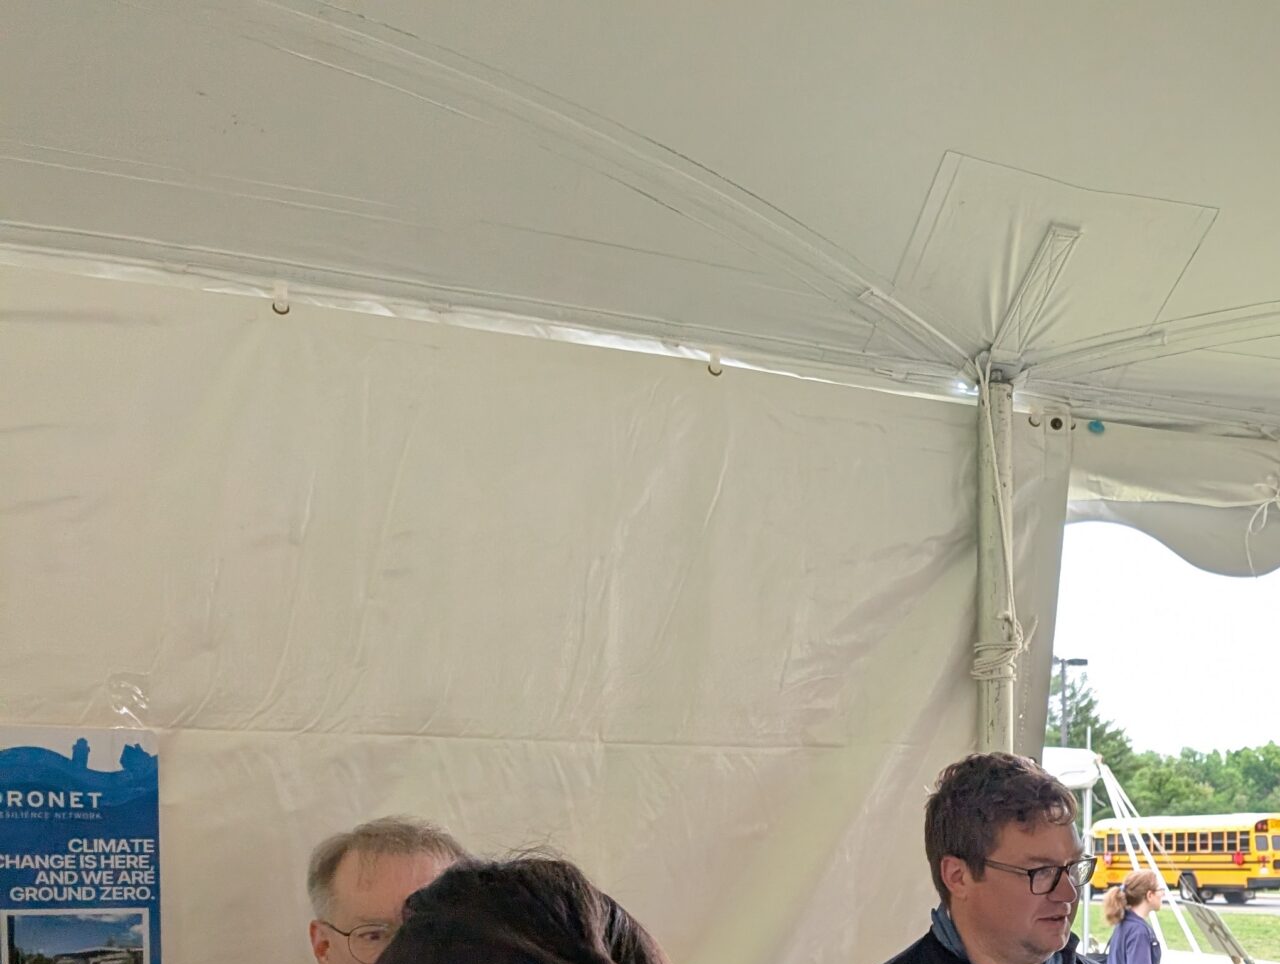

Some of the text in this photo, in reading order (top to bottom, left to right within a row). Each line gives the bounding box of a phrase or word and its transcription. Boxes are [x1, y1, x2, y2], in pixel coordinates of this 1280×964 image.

[0, 790, 102, 808] RONET
[67, 838, 155, 853] CLIMATE
[79, 854, 97, 869] IS
[100, 854, 155, 871] HERE,
[35, 870, 156, 885] AND WE ARE
[9, 886, 156, 901] GROUND ZERO.
